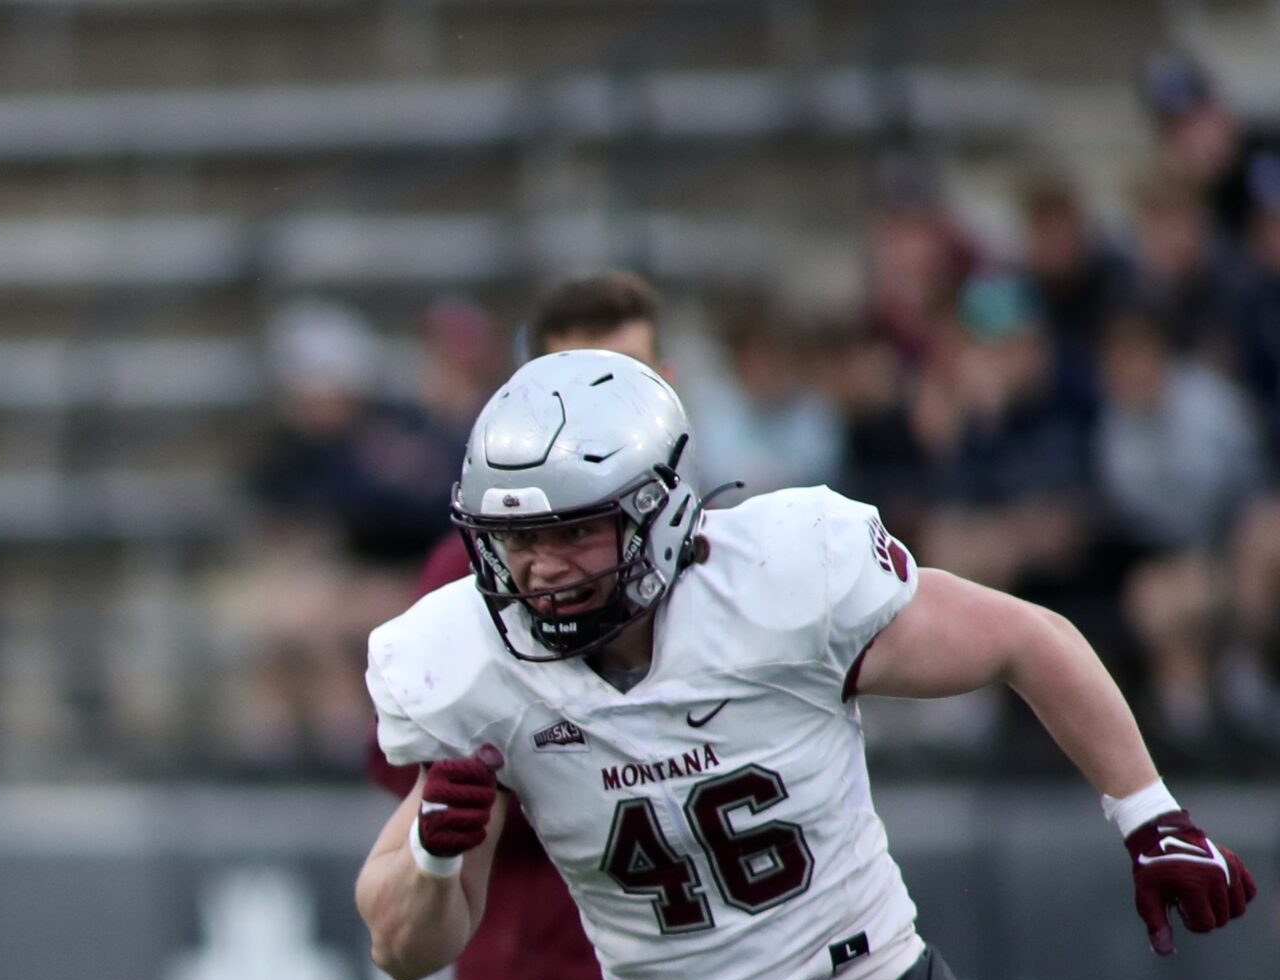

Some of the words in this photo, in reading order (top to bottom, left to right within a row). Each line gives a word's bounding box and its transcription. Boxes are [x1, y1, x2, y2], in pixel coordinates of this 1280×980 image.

[601, 743, 720, 791] MONTANA
[600, 763, 815, 934] 46
[845, 943, 857, 957] L
